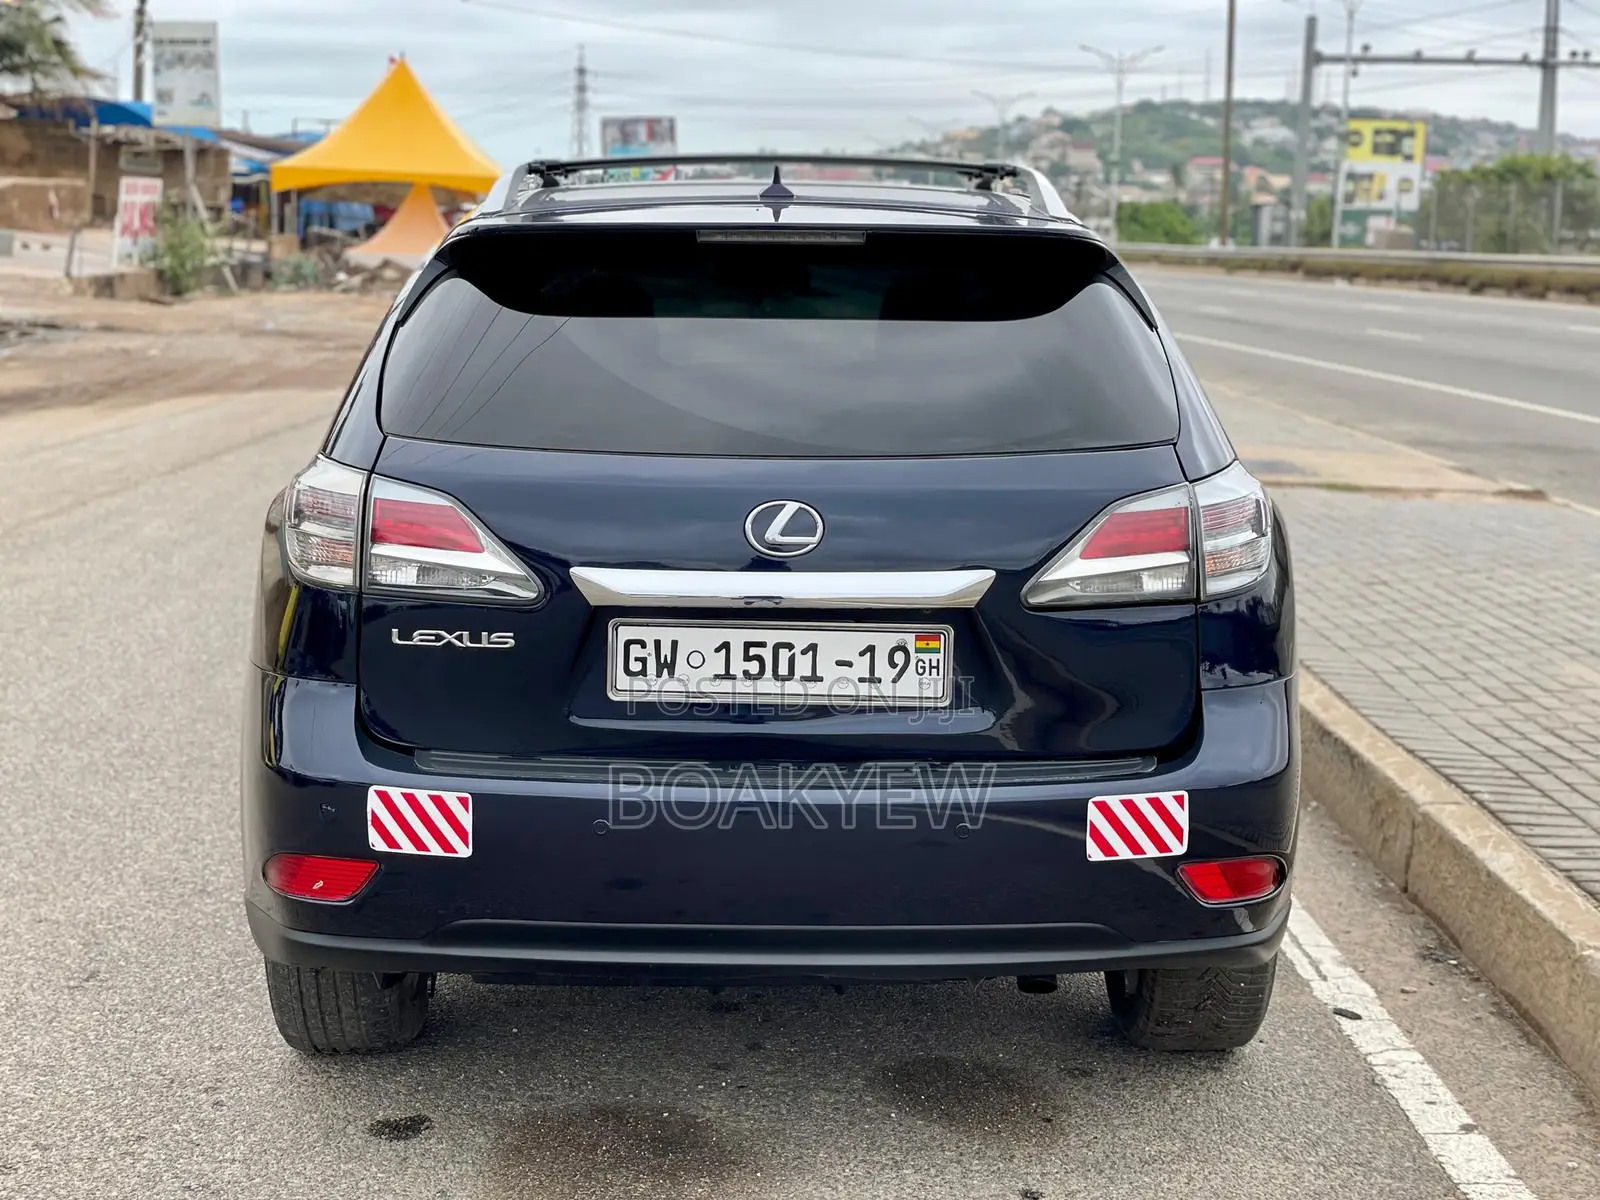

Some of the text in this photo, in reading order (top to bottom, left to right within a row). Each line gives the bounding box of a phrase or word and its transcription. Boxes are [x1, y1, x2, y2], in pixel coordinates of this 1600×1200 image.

[391, 628, 516, 649] LEXUS
[622, 638, 679, 679] GW
[914, 658, 940, 677] GH
